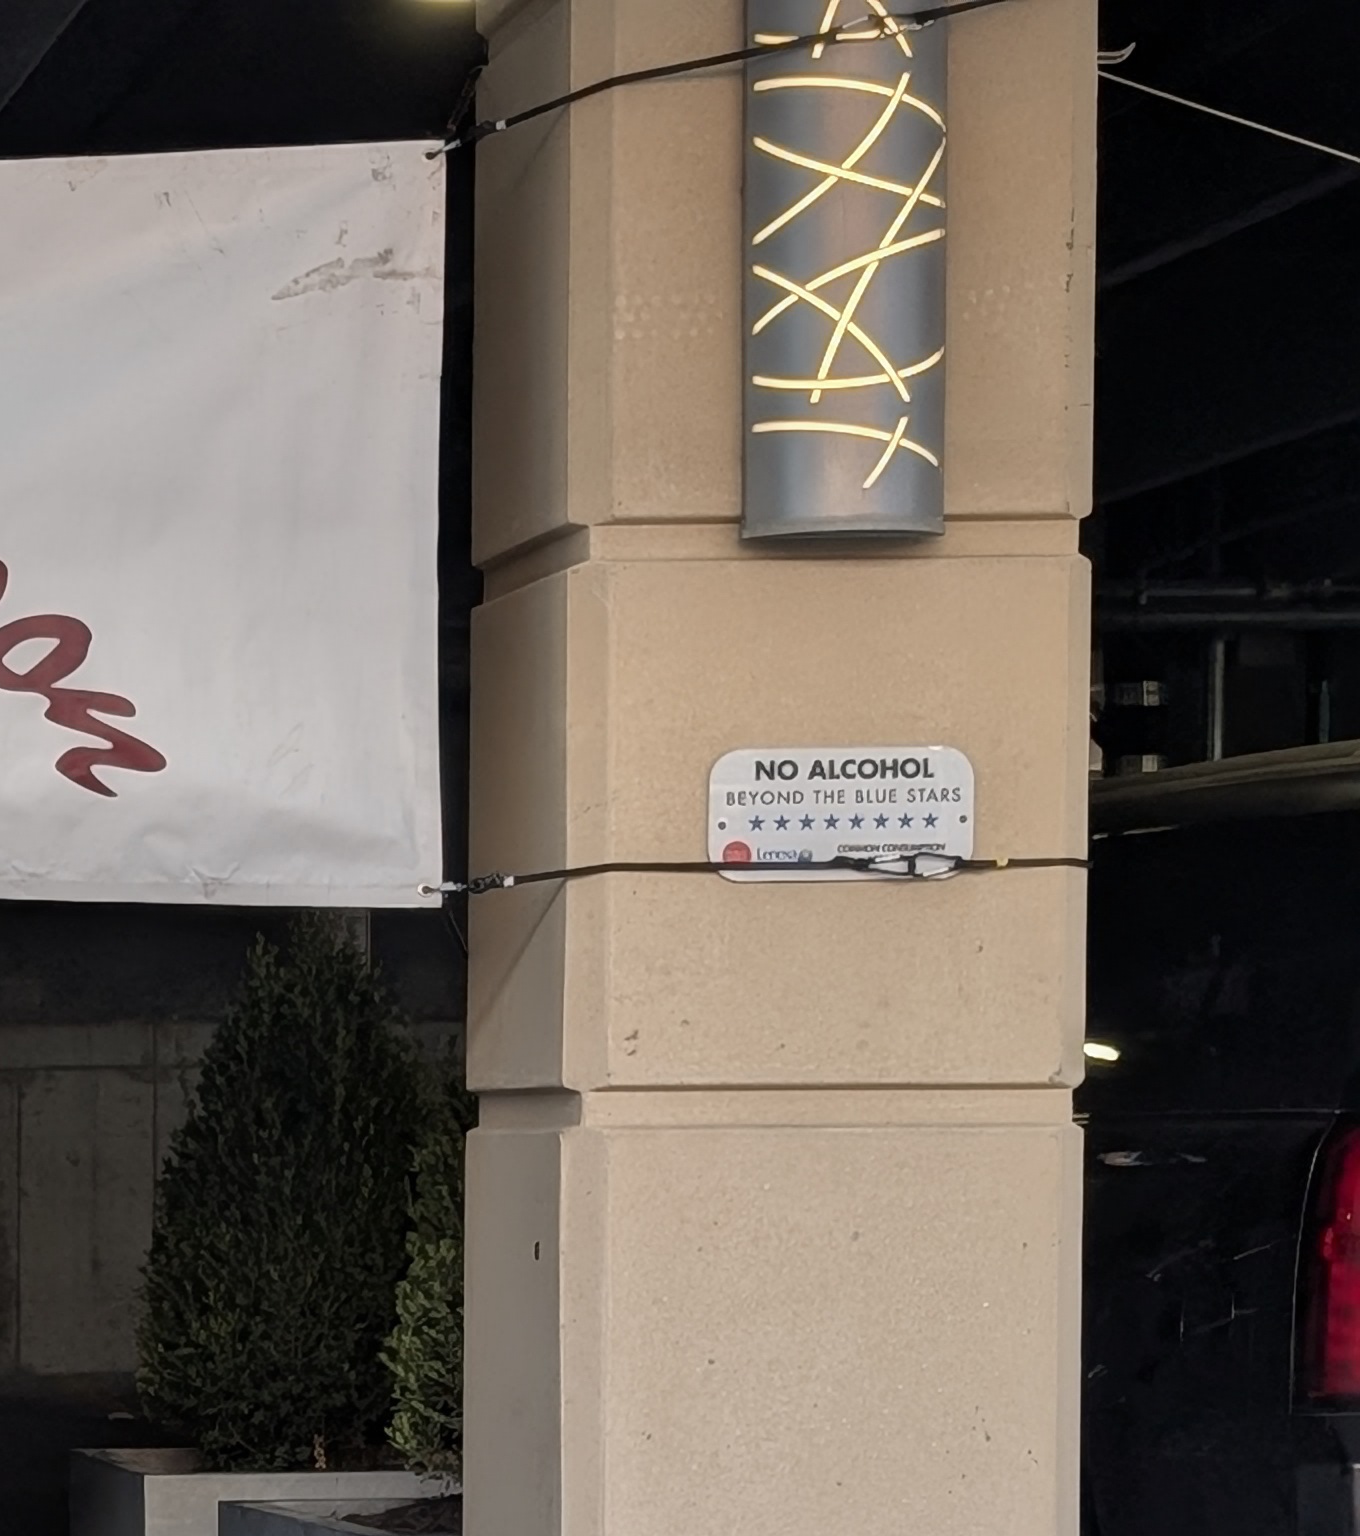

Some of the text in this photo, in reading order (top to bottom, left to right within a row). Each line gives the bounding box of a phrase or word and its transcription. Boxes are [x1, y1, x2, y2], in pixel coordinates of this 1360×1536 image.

[754, 757, 935, 781] NO ALCOHOL
[726, 786, 961, 806] BEYOND THE BLUE STARS
